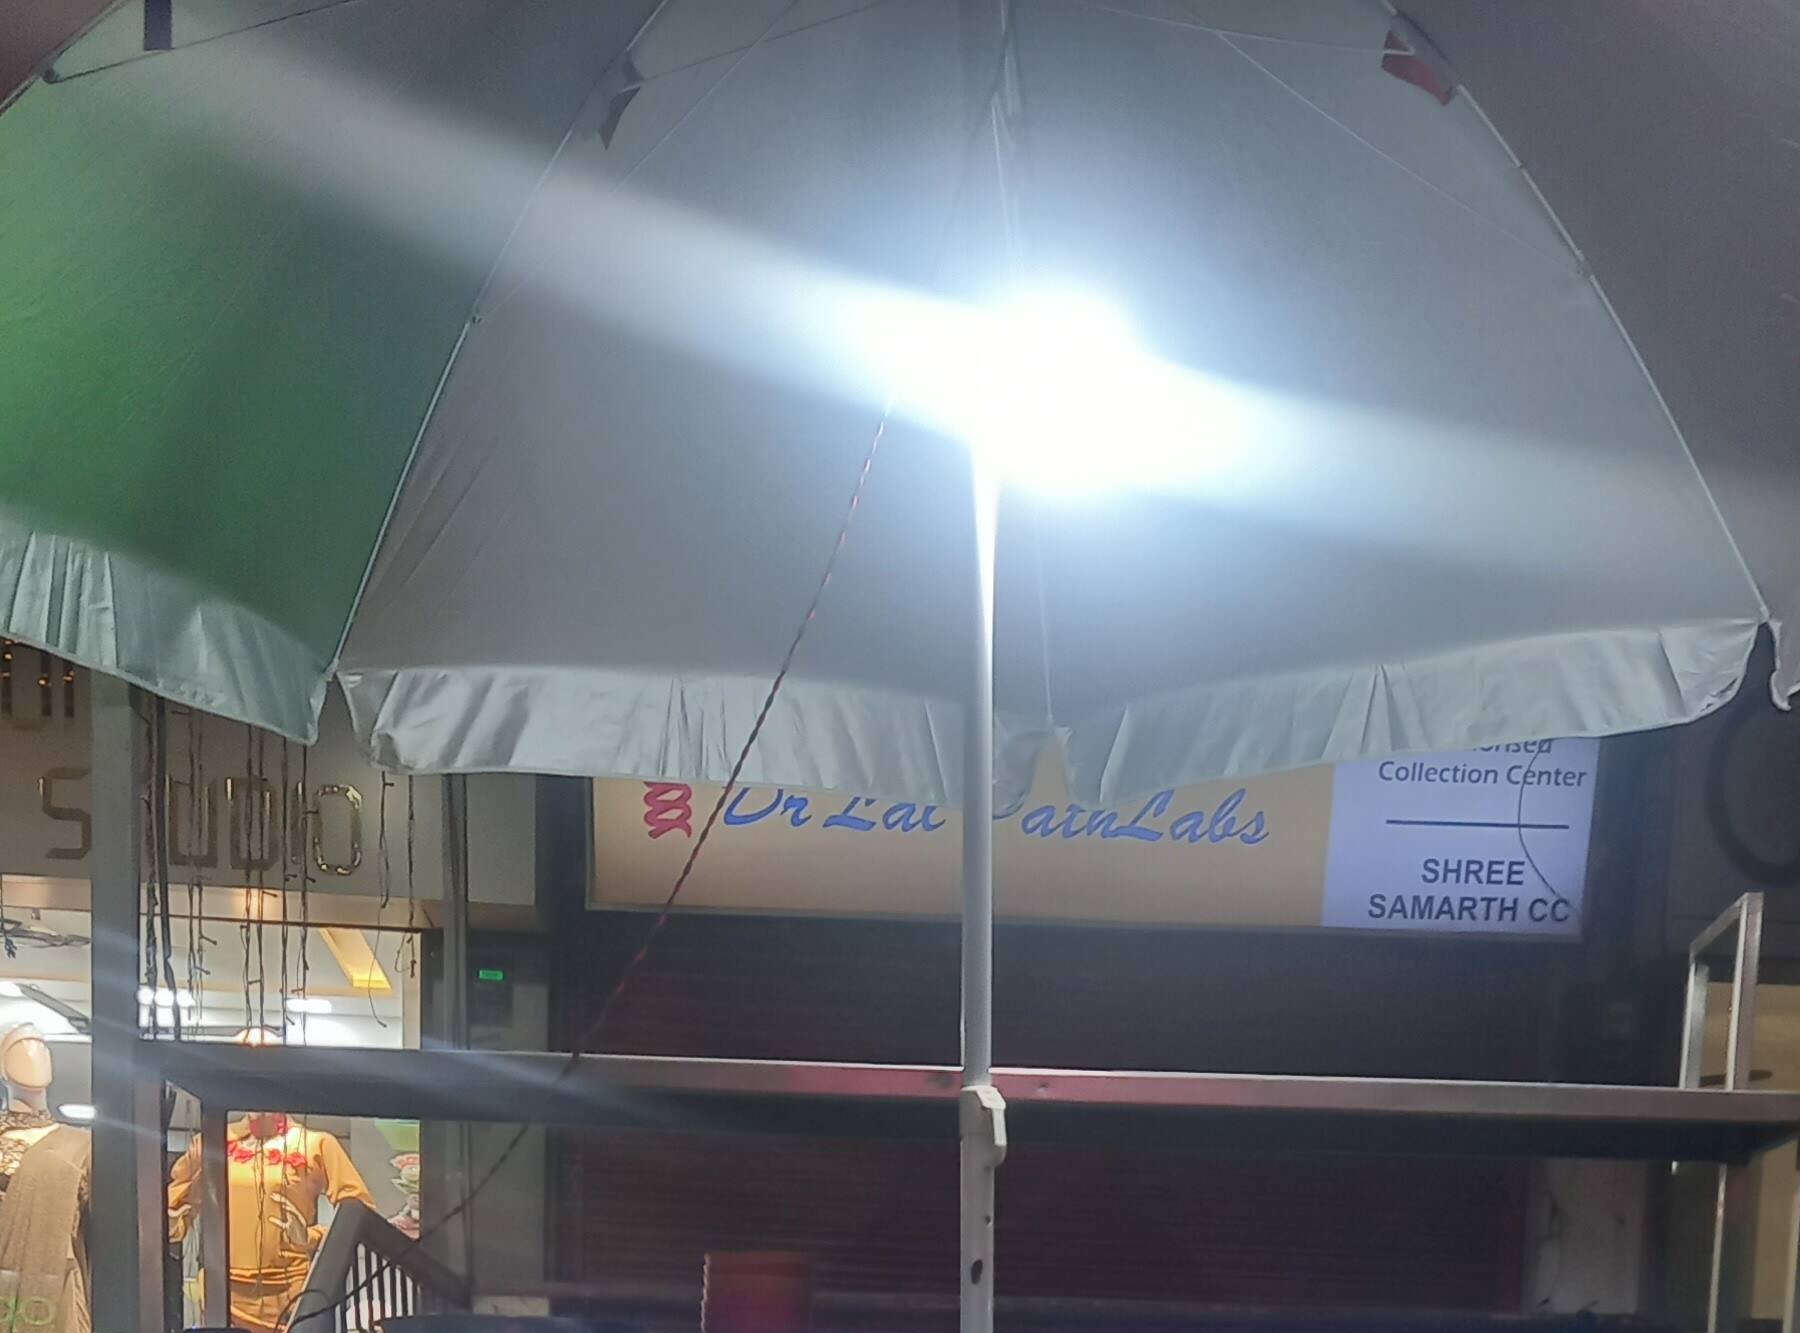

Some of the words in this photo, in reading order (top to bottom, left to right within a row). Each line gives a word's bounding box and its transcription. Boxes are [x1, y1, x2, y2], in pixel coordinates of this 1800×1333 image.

[1378, 761, 1498, 785] Collection
[1506, 764, 1587, 787] Center
[38, 766, 362, 876] SUDIO
[1022, 788, 1268, 844] athLabs
[1421, 858, 1525, 886] SHREE
[1368, 894, 1518, 922] SAMARTH
[1529, 898, 1570, 923] CC
